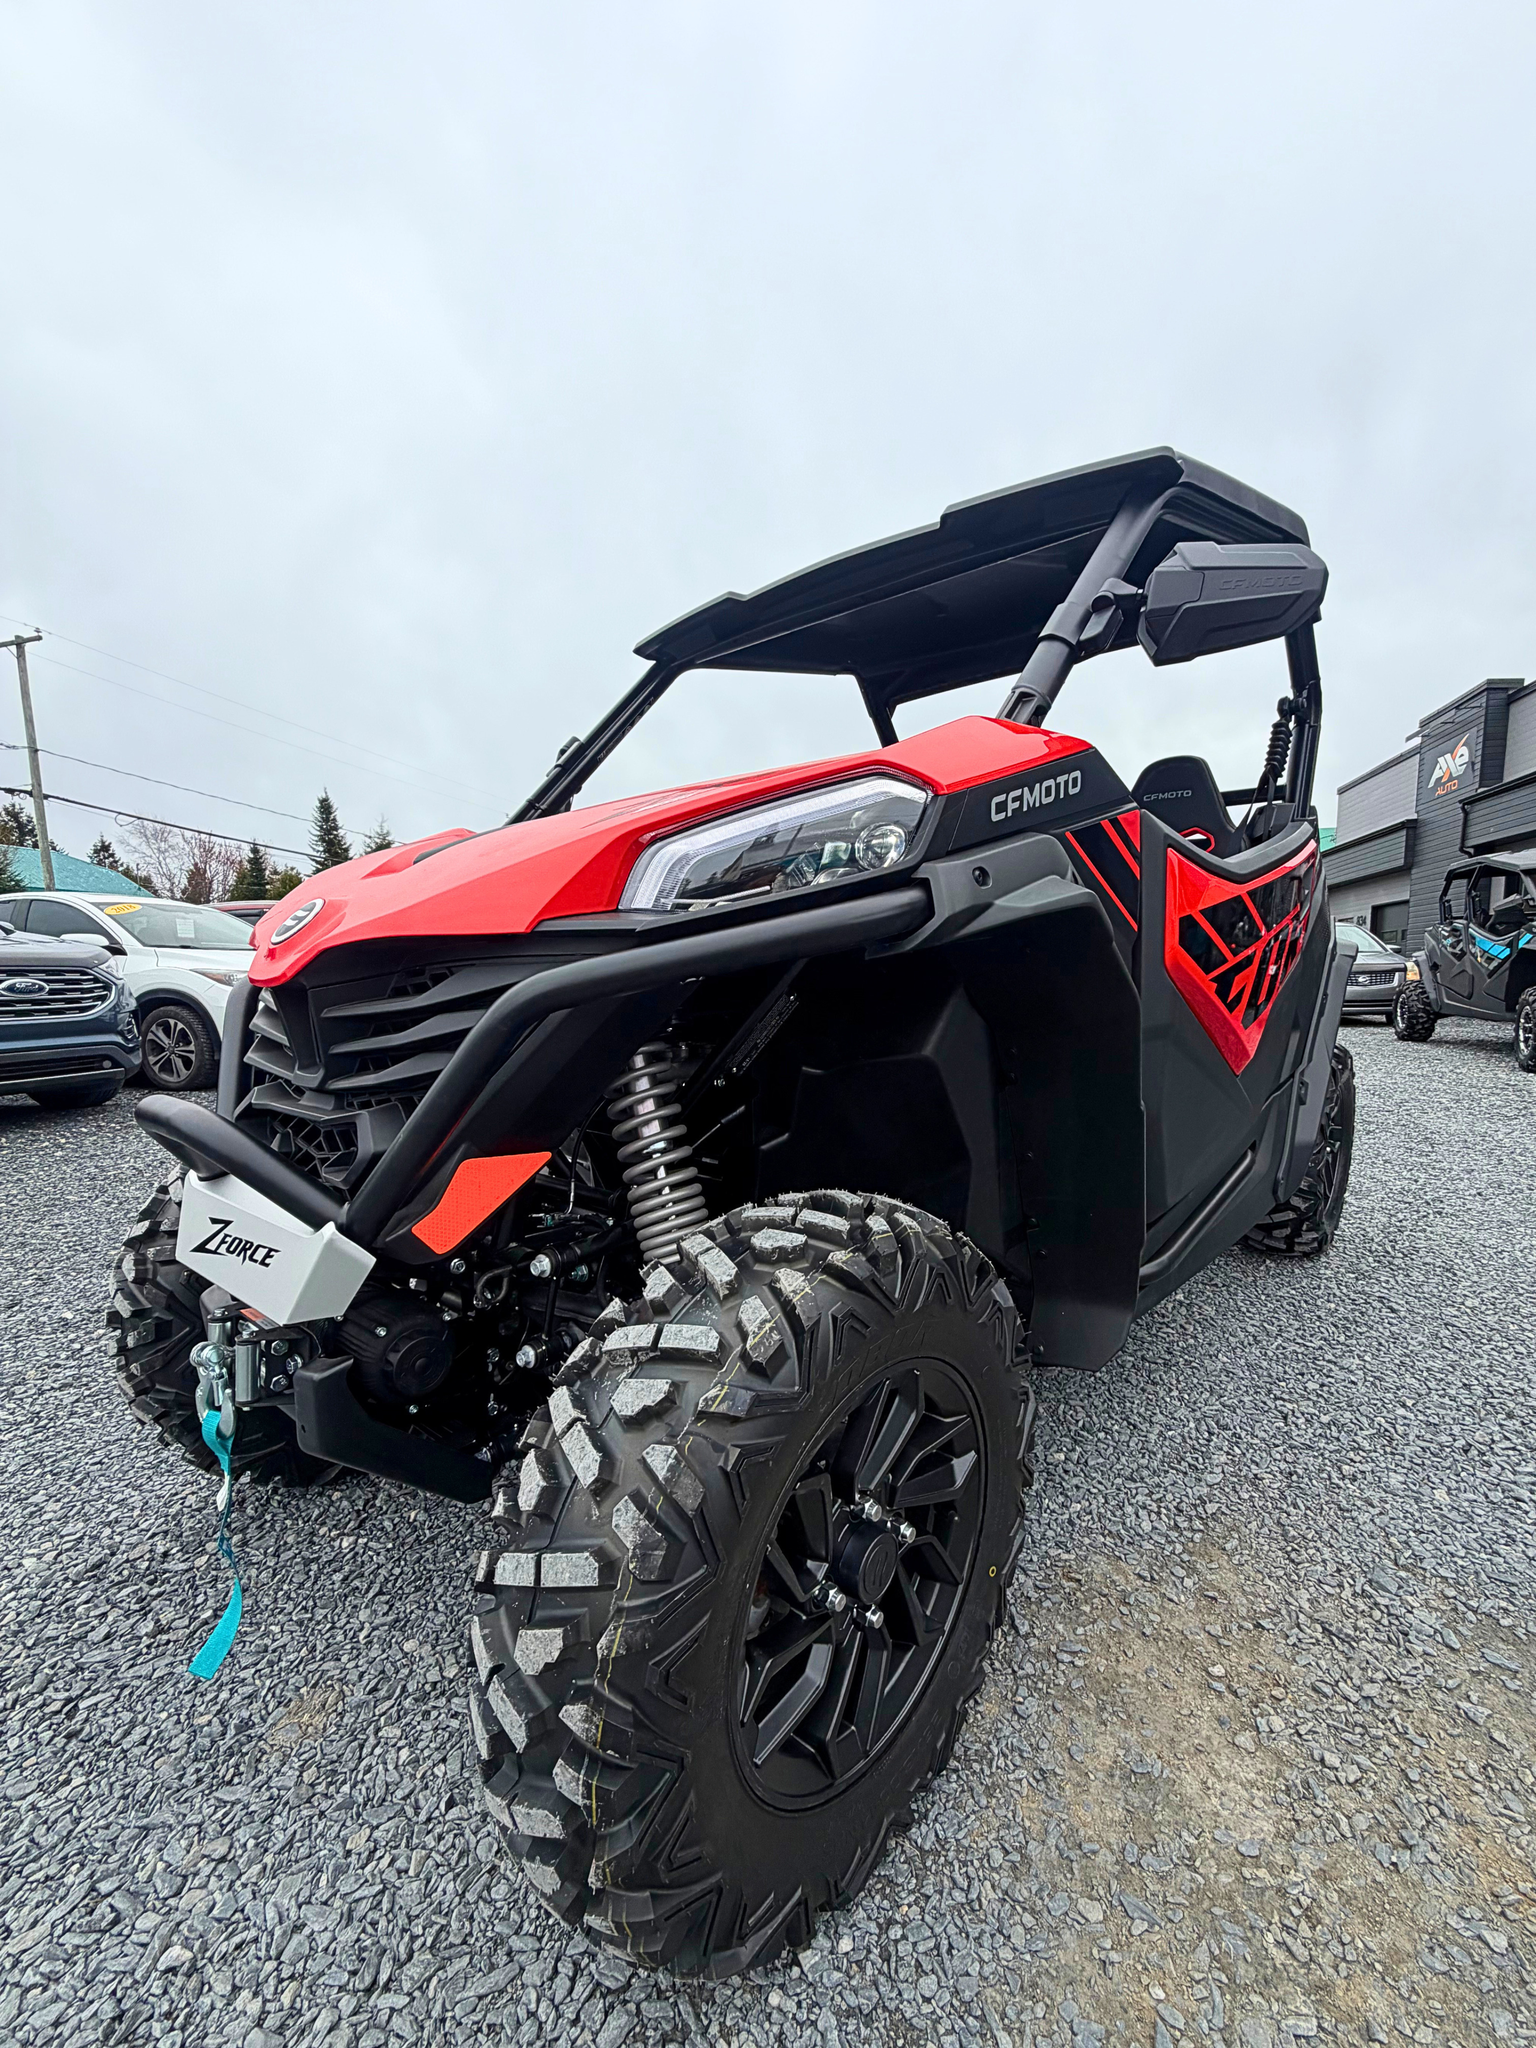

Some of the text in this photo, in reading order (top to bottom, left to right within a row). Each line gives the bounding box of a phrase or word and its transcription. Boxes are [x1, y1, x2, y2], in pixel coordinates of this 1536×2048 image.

[1219, 575, 1303, 590] CFMOTO
[1143, 789, 1192, 802] CFMOTO
[1435, 780, 1458, 796] AUTO
[990, 770, 1082, 822] CFMOTO
